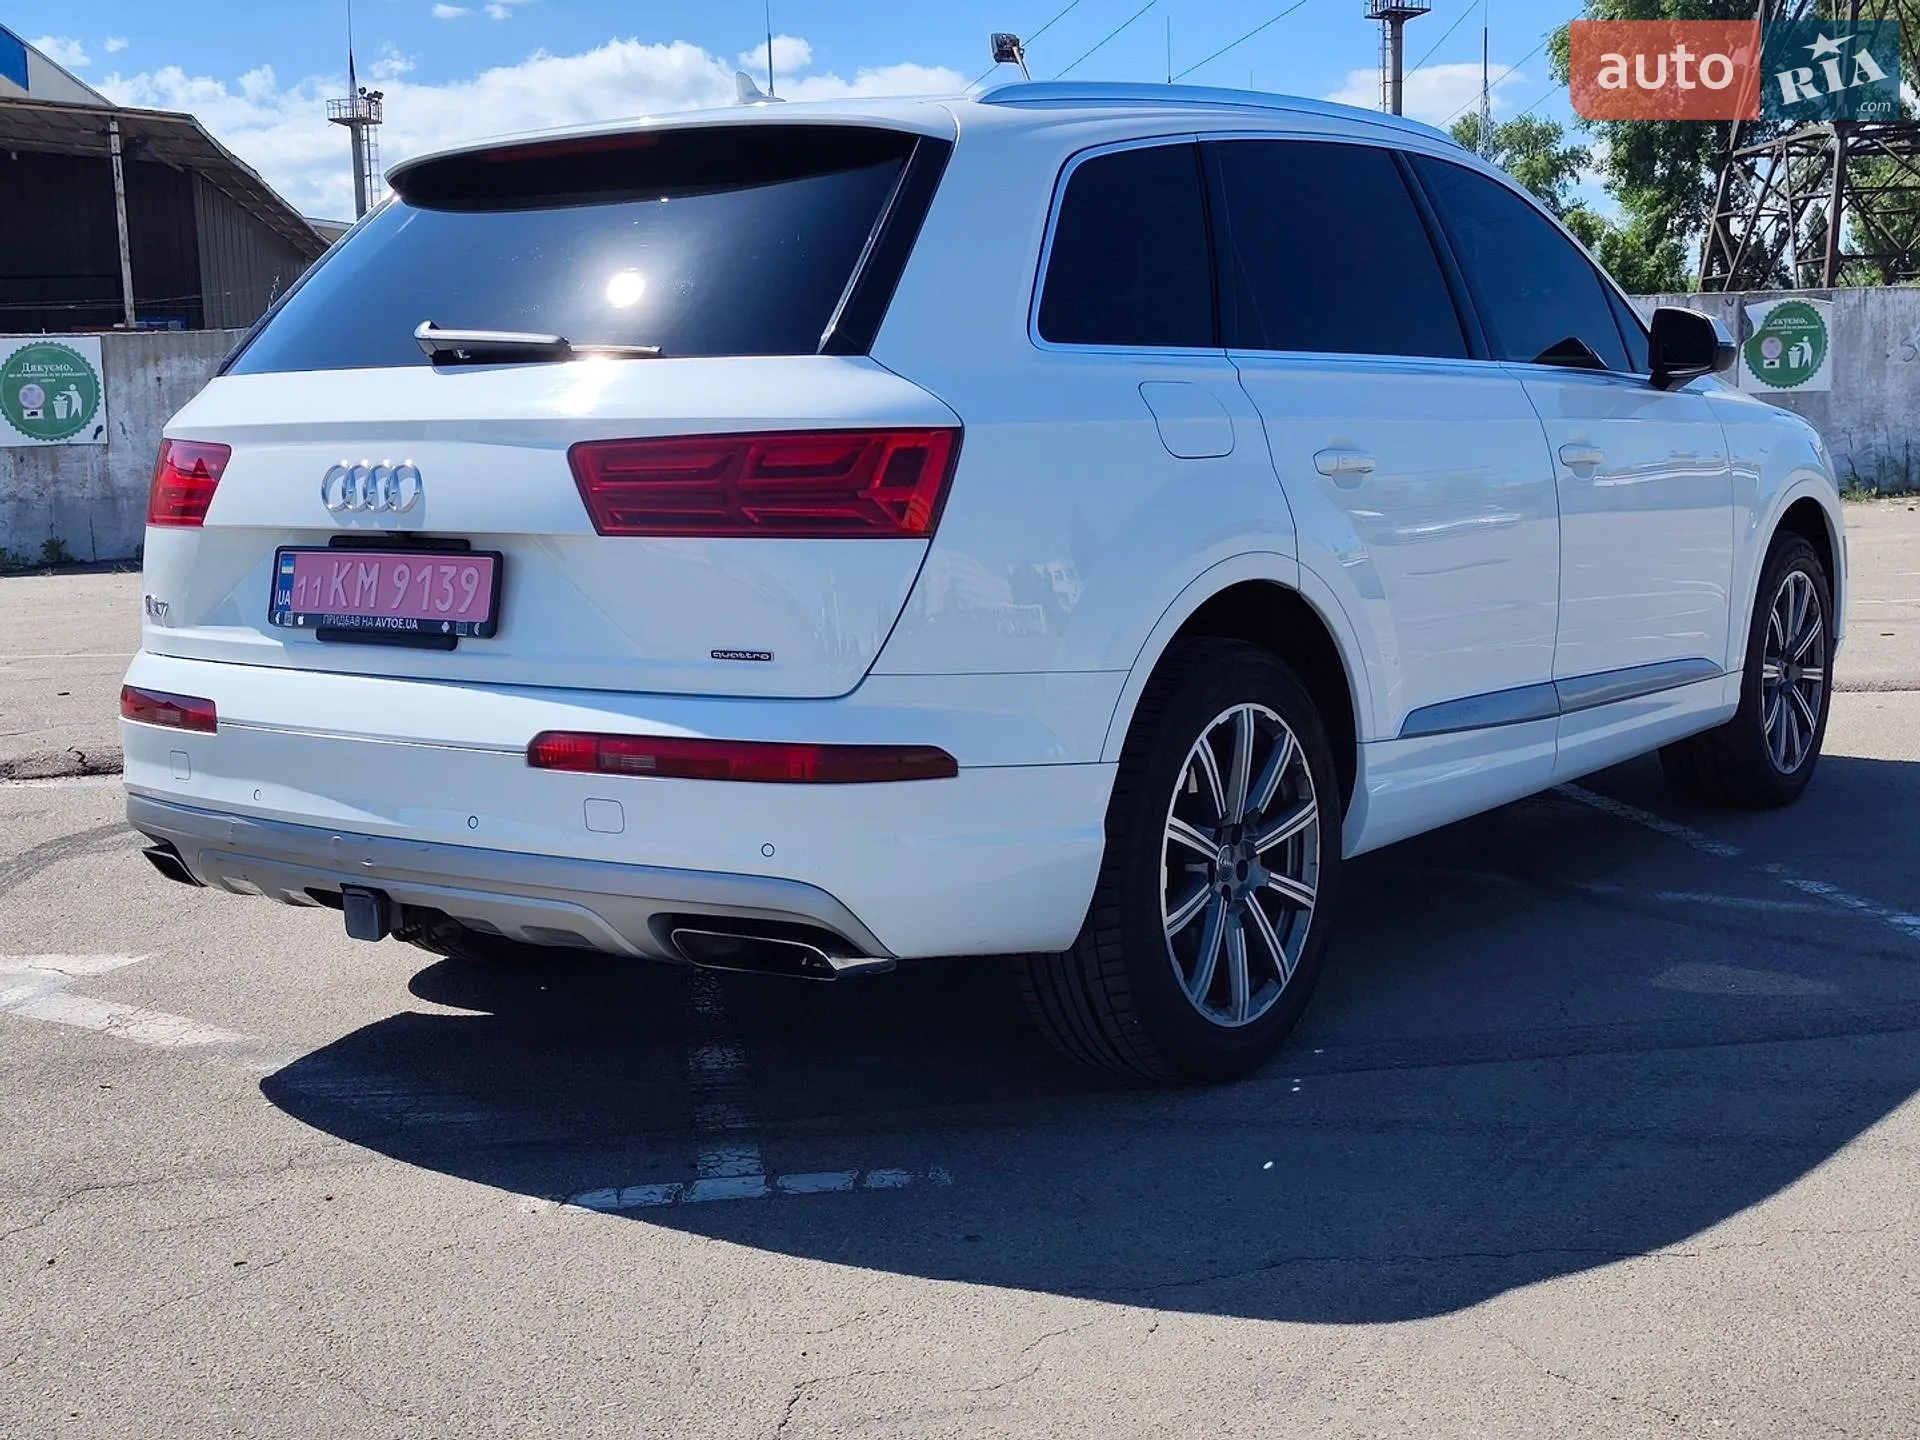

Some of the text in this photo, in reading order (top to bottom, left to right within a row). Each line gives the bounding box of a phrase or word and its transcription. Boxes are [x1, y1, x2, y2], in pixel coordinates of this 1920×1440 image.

[297, 575, 322, 607] 11
[391, 564, 480, 613] 9139
[278, 590, 291, 605] UA
[323, 614, 418, 629] ПРИДБАВ НА AVTOE.UA
[712, 651, 771, 660] quattro
